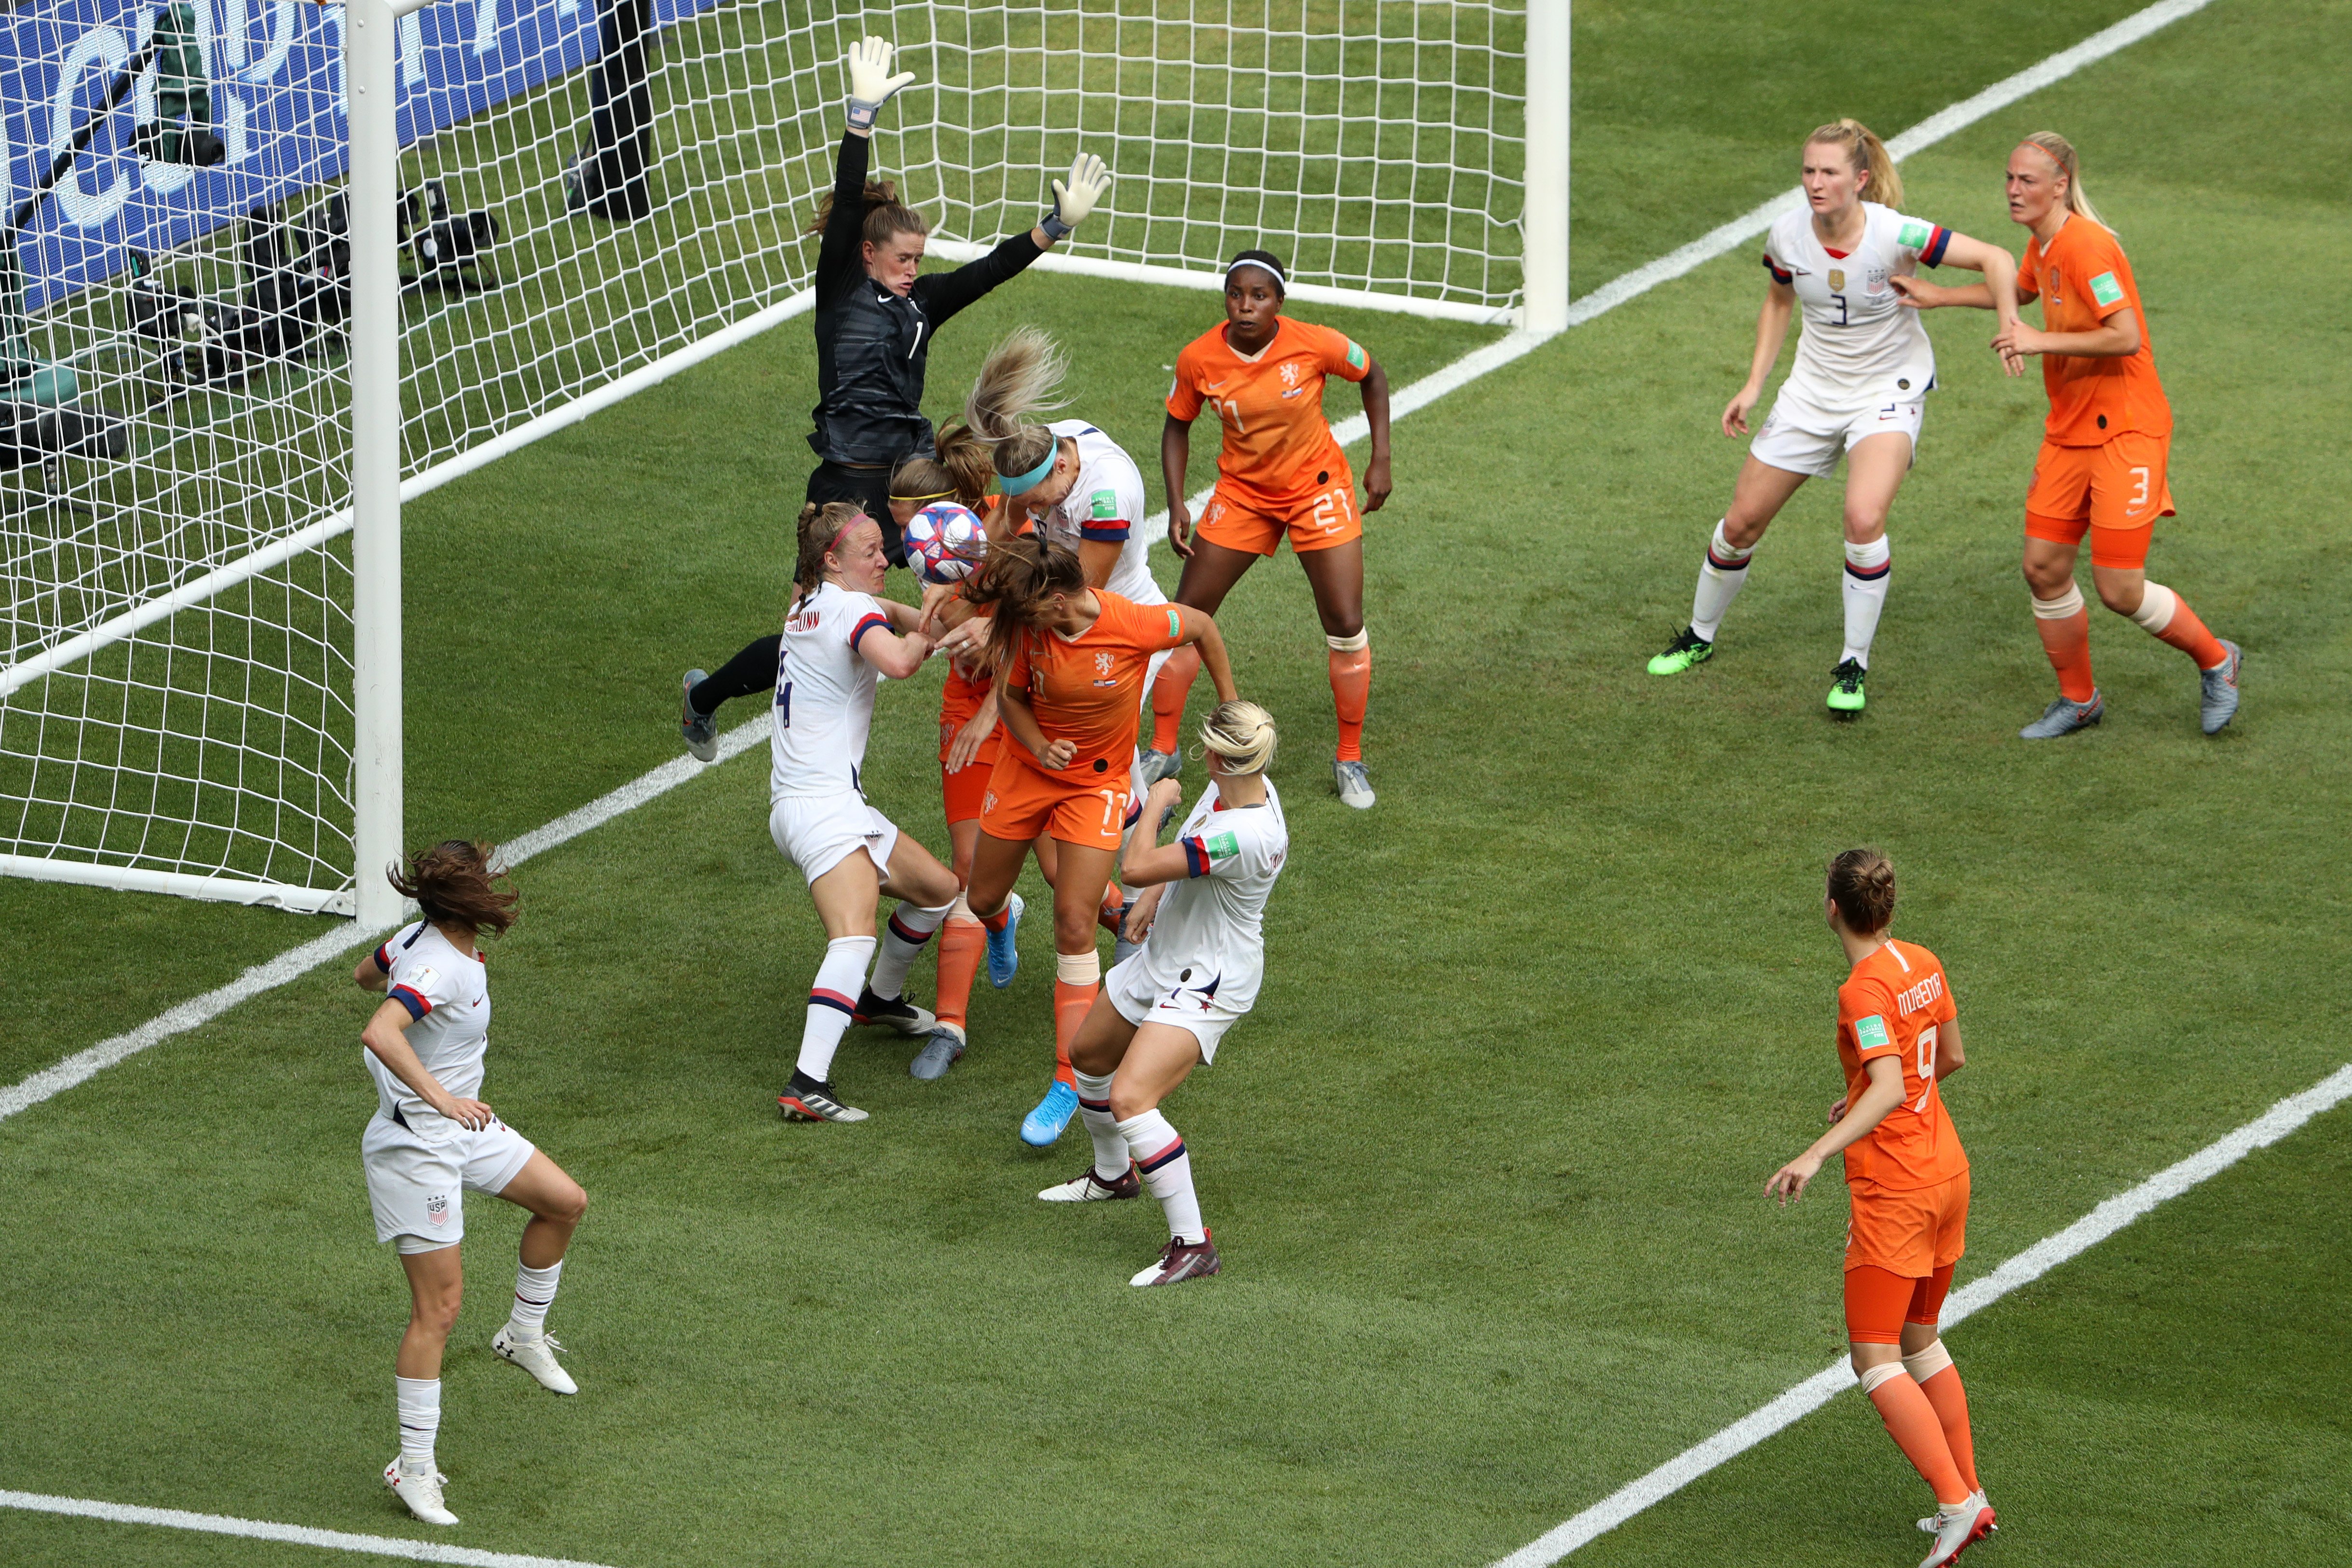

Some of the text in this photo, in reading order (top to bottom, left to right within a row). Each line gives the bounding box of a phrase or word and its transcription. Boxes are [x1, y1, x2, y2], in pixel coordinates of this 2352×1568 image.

[1831, 294, 1847, 325] 3
[908, 322, 923, 360] 1
[2129, 467, 2149, 505] 3
[1313, 488, 1352, 526] 21
[776, 650, 792, 729] 4
[1100, 789, 1128, 830] 11
[1859, 1023, 1882, 1032] LIVING
[1860, 1026, 1882, 1035] FOOTBALL
[1914, 1025, 1937, 1113] 9
[429, 1201, 446, 1213] USA
